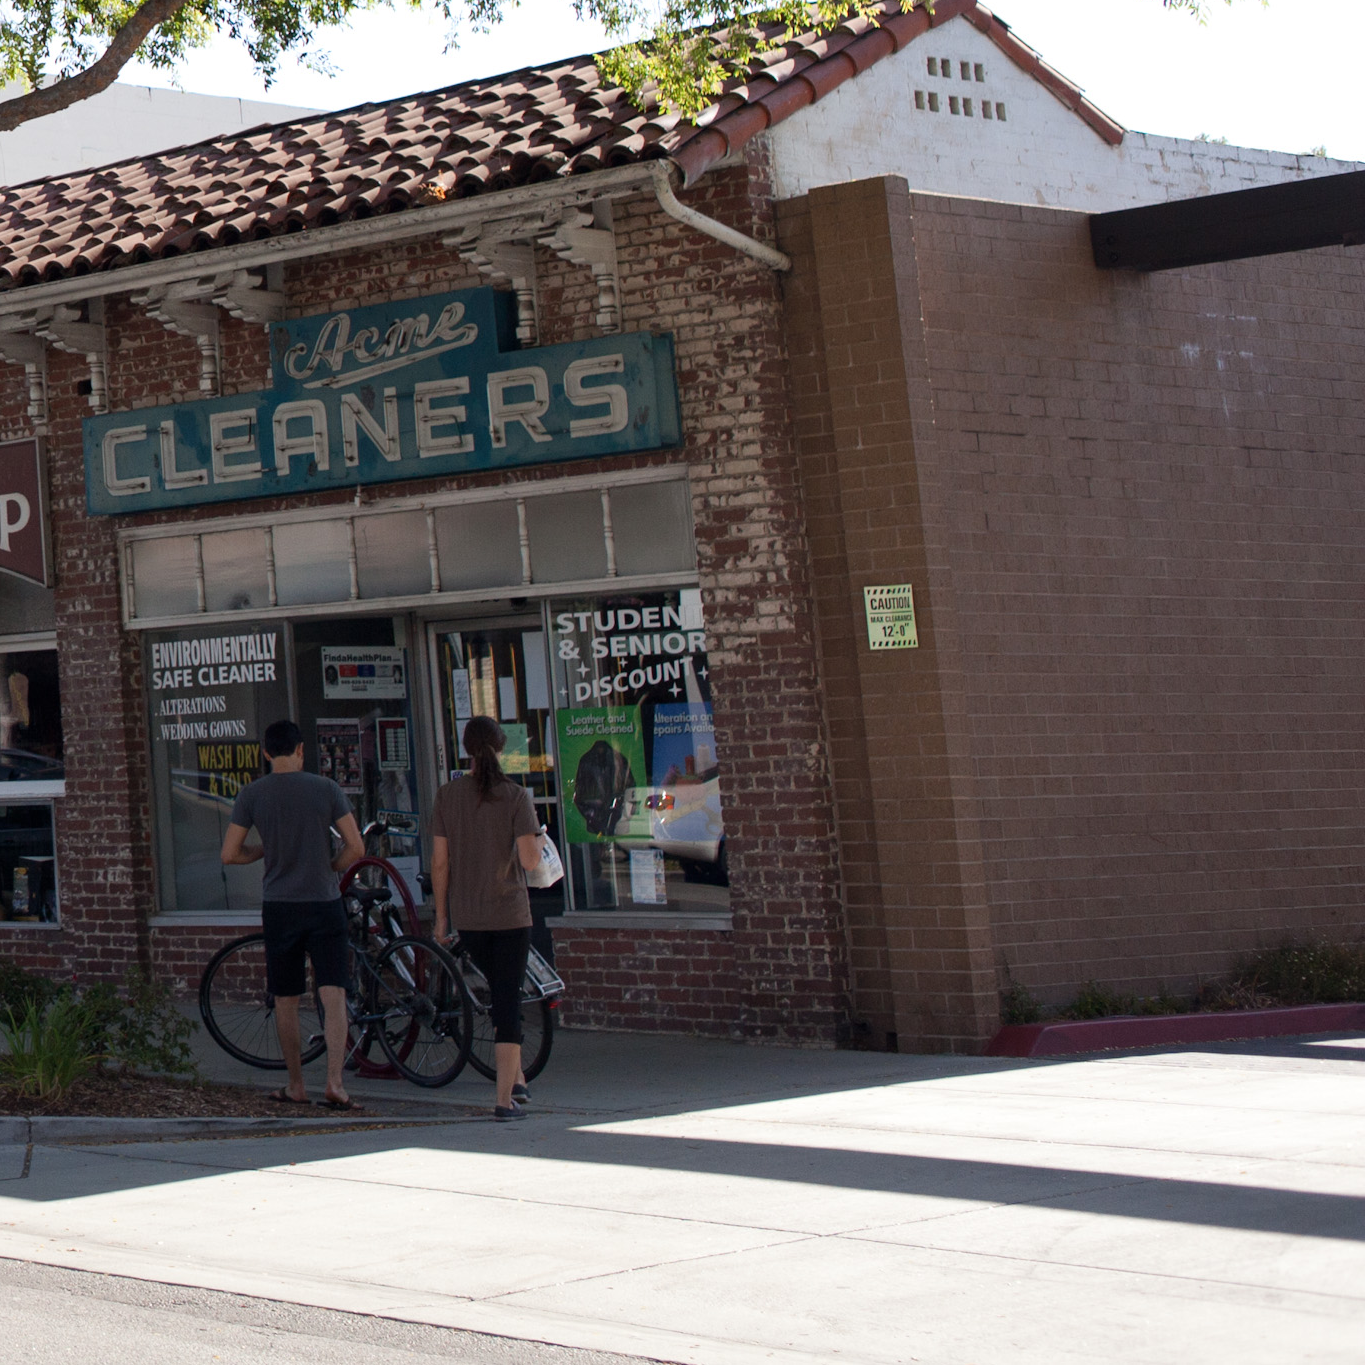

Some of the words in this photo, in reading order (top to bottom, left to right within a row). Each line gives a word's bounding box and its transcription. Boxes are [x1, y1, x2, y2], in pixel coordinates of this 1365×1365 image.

[283, 301, 478, 384] Acme
[103, 352, 629, 497] CLEANERS
[870, 597, 910, 610] CAUTION
[885, 614, 912, 622] CLEARANCE
[152, 633, 277, 669] ENVIRONMENTALLY
[558, 639, 580, 660] &
[591, 632, 707, 659] SENIOR
[152, 669, 193, 690] SAFE
[198, 663, 277, 687] CLEANER
[575, 656, 693, 702] DISCOUNT
[159, 696, 226, 716] ALTERATIONS
[566, 725, 594, 736] Suede
[596, 722, 634, 734] Cleaned
[571, 714, 605, 725] Leather
[609, 712, 626, 722] and
[702, 714, 713, 723] an
[161, 722, 207, 740] WEDDING
[209, 720, 246, 738] GOWNS
[654, 724, 682, 737] epairs
[198, 745, 233, 770] WASH
[236, 744, 260, 769] DRY
[209, 773, 218, 796] &
